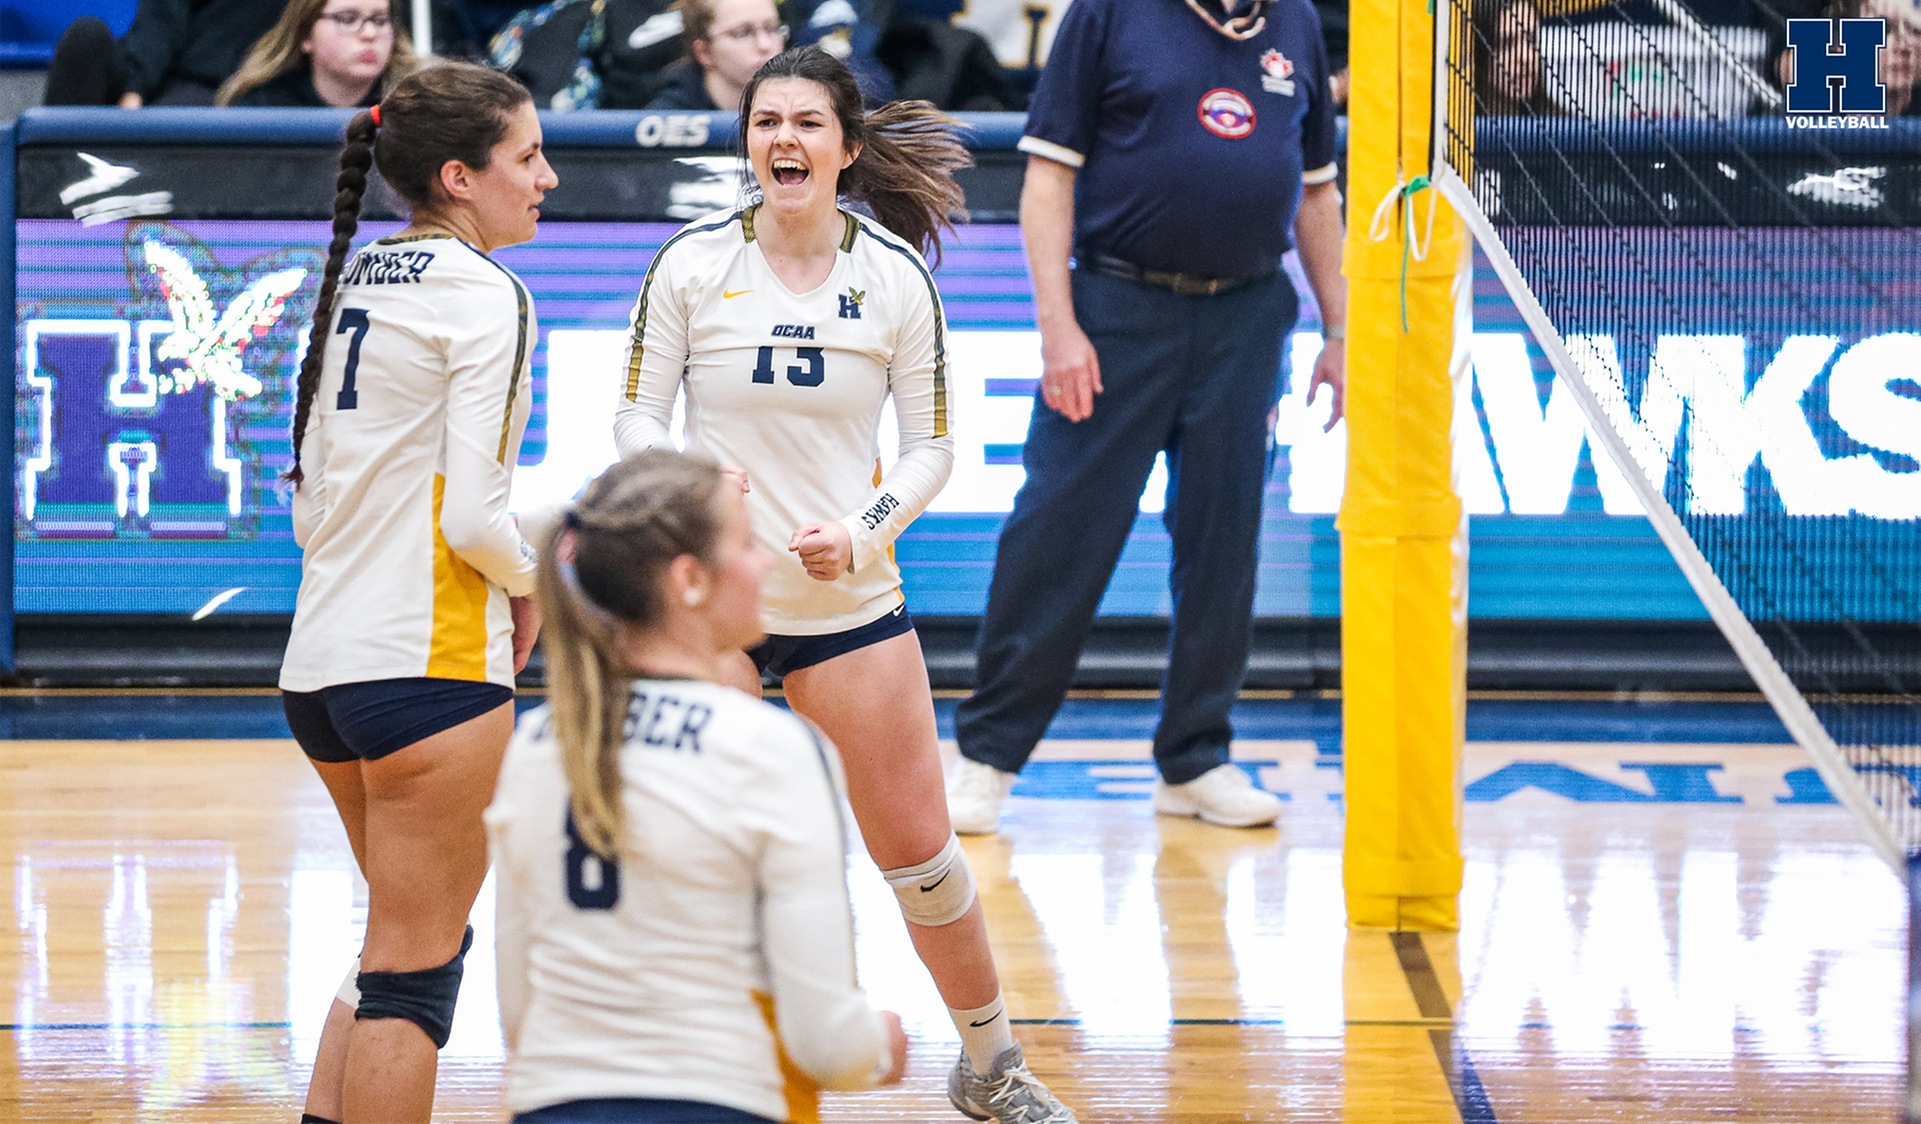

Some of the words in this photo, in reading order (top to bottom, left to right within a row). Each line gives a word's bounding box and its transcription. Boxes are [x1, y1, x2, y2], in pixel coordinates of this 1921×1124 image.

[635, 114, 711, 148] OES
[771, 324, 816, 340] OCAA
[336, 308, 370, 410] 7
[751, 345, 825, 388] 13
[861, 492, 900, 531] HAWKS
